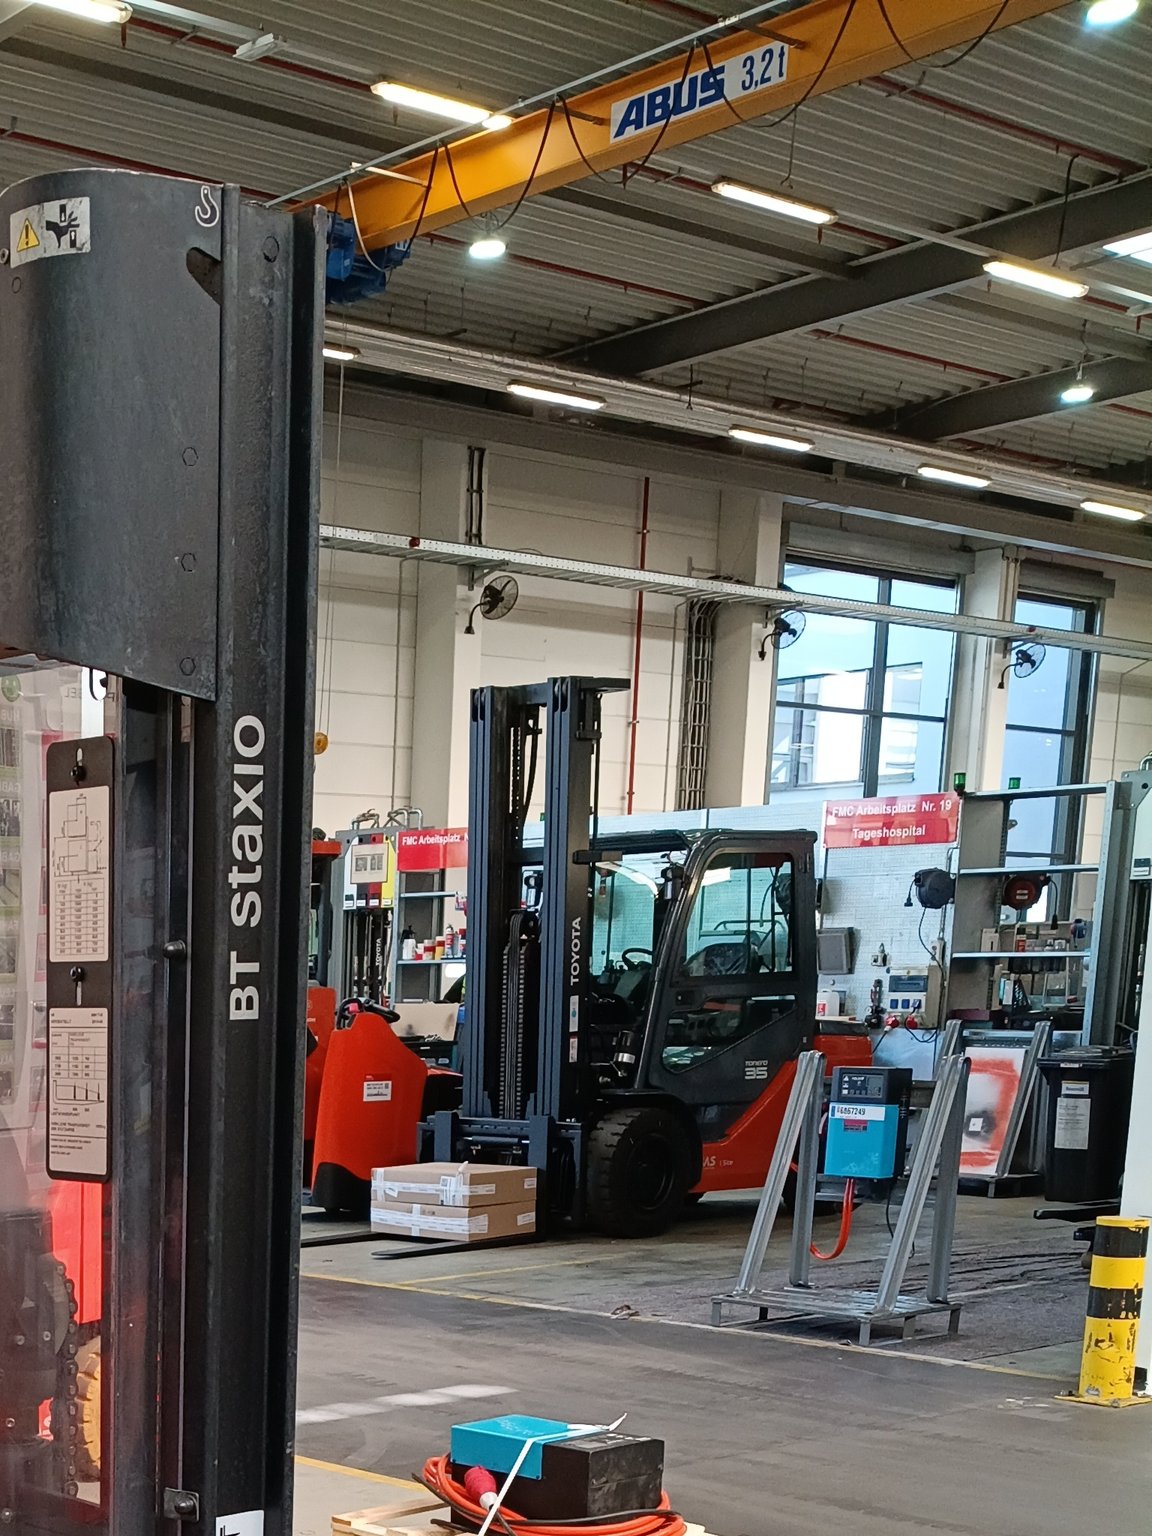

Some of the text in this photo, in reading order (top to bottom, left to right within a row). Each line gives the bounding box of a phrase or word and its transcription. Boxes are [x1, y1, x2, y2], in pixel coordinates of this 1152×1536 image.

[614, 64, 726, 139] ABUS
[741, 48, 774, 91] 3,2
[832, 800, 952, 817] FMC Arbeitsplatz Nr. 19
[402, 835, 418, 846] FMC
[418, 833, 460, 847] Arbeitsplatz
[852, 824, 926, 841] Tageshospital
[375, 937, 383, 966] TOYOTA
[570, 916, 582, 986] TOYOTA
[229, 950, 260, 1021] BT
[744, 1067, 768, 1079] 35
